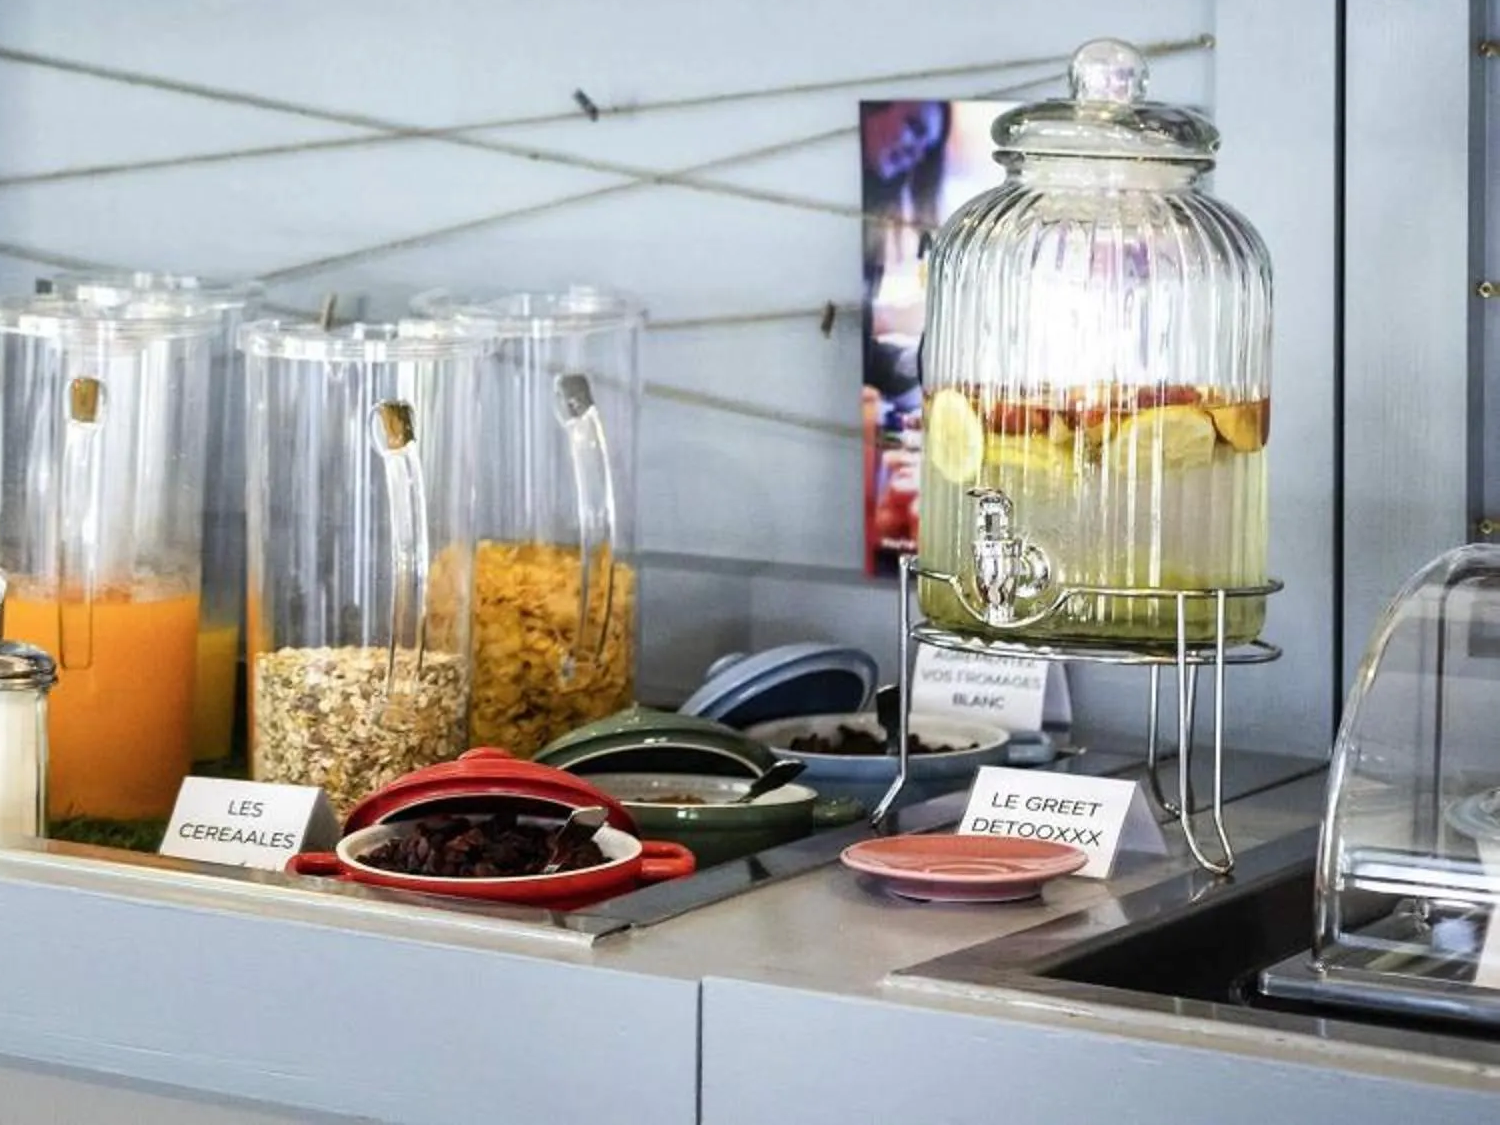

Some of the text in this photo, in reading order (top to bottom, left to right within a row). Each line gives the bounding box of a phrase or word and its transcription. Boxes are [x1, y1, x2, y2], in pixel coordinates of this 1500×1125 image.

[952, 692, 1006, 709] BLANC
[227, 800, 264, 818] LES
[991, 791, 1103, 817] LE GREET
[179, 822, 296, 849] CEREAALES
[971, 817, 1103, 847] DETOOXXX
